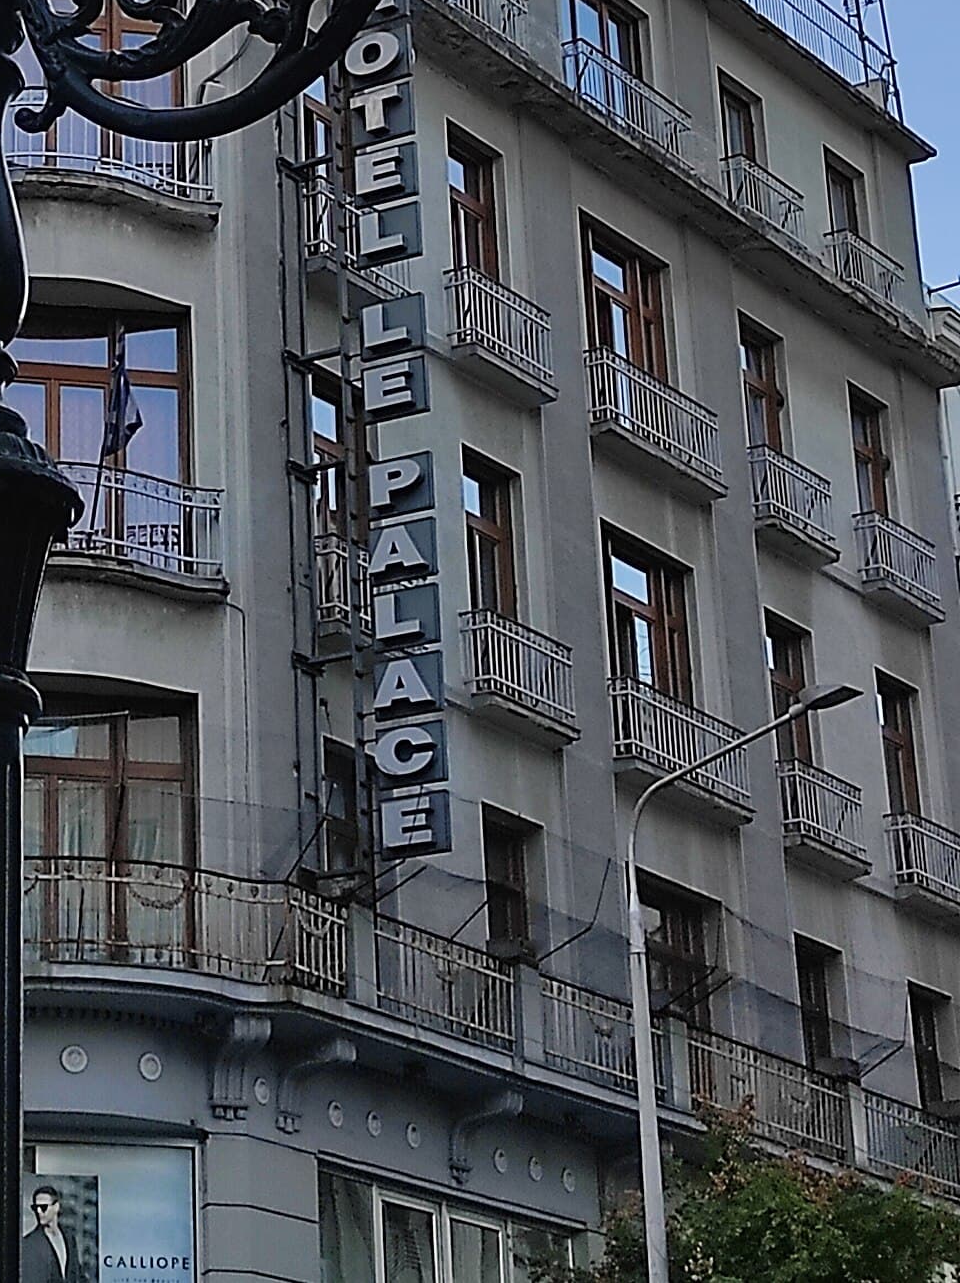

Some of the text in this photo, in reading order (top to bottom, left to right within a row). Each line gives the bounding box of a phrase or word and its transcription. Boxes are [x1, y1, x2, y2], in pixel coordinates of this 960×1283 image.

[363, 303, 413, 411] LE
[369, 459, 435, 849] PALACE
[103, 1255, 190, 1270] CALLIOPE
